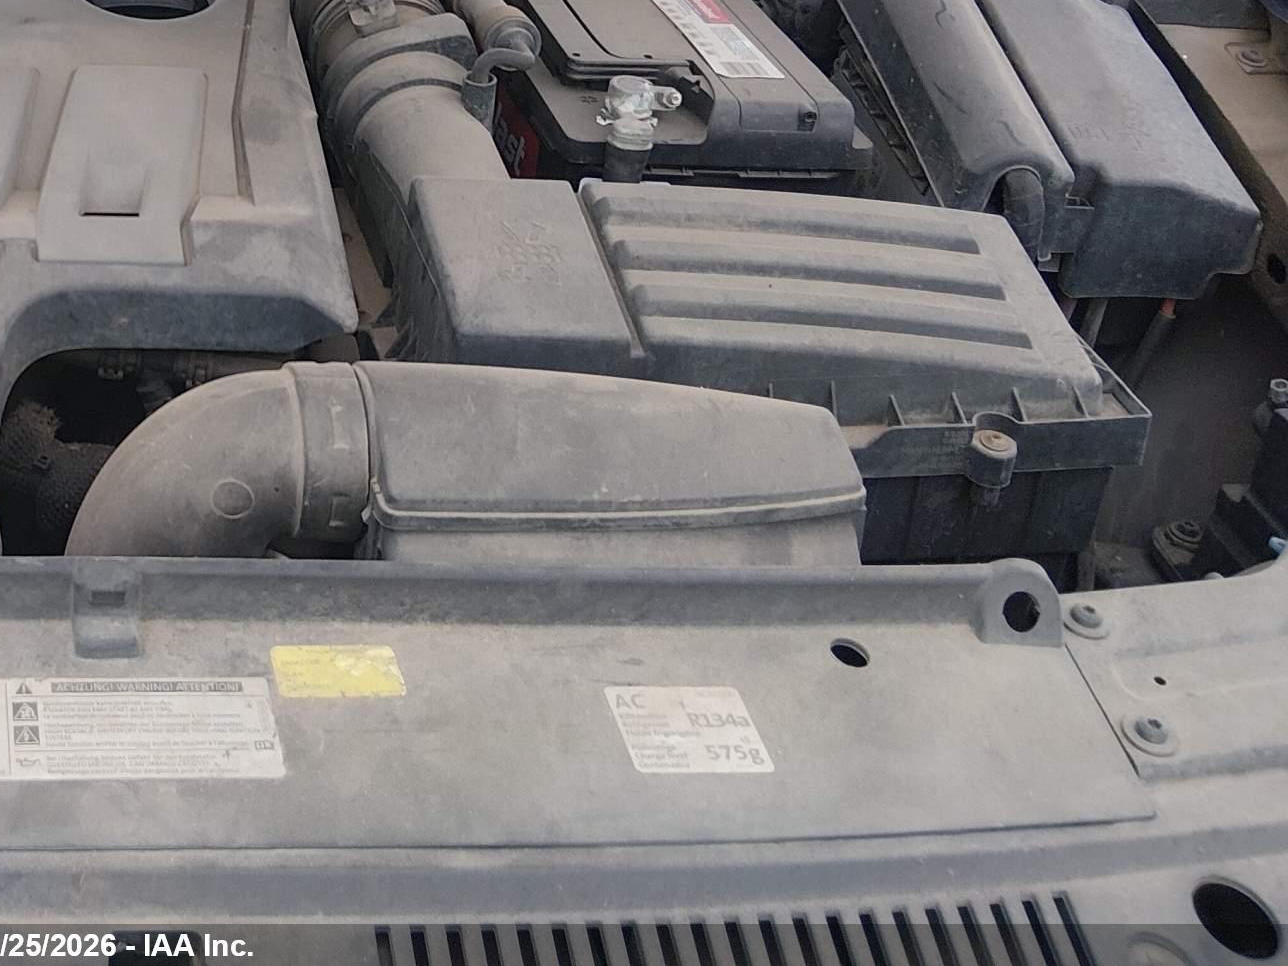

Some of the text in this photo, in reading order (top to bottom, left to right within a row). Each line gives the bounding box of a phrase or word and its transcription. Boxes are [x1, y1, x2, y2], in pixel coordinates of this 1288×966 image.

[55, 682, 240, 692] ACHTUNG! WARNING! ATTENTION!
[615, 693, 648, 709] AC
[686, 712, 751, 728] R134a
